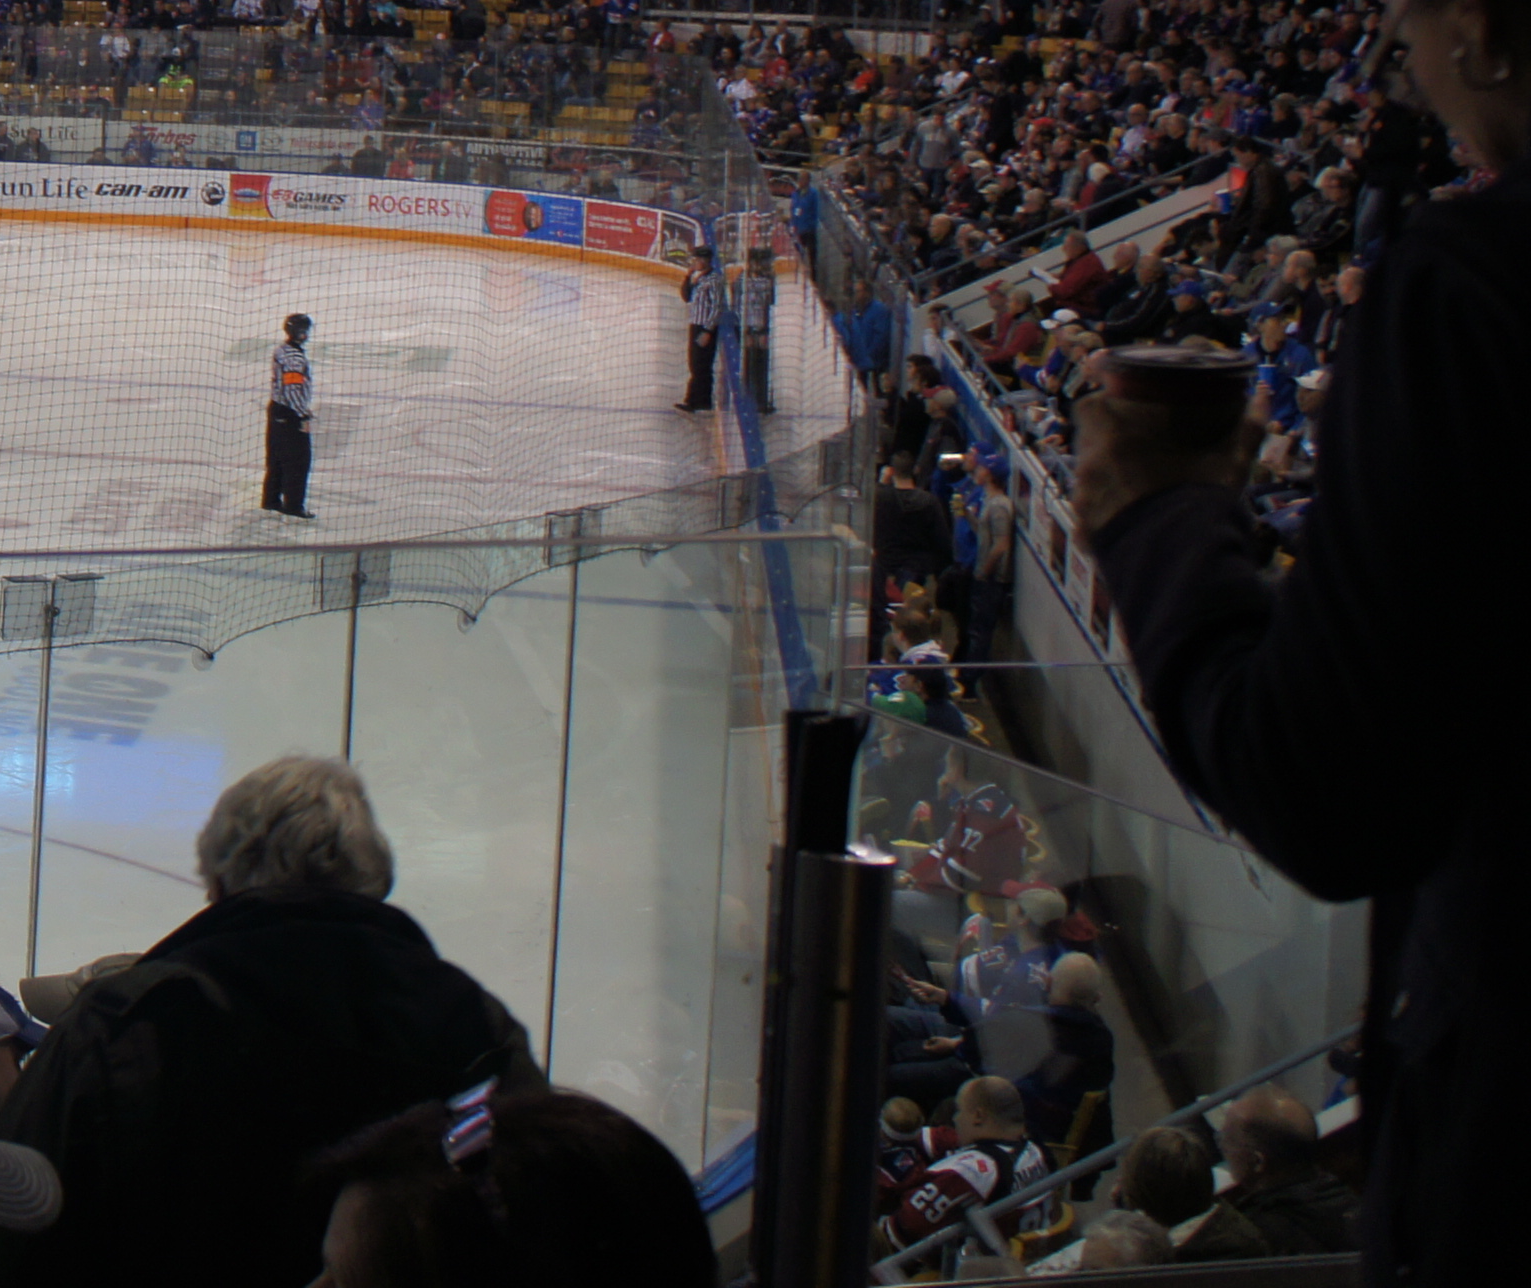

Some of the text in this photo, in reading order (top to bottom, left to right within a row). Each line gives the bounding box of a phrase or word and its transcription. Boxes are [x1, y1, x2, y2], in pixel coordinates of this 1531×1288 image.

[38, 176, 87, 200] Life
[95, 183, 188, 200] can-am
[293, 192, 347, 205] GAMES
[368, 195, 450, 217] ROGERS
[455, 200, 472, 218] tv
